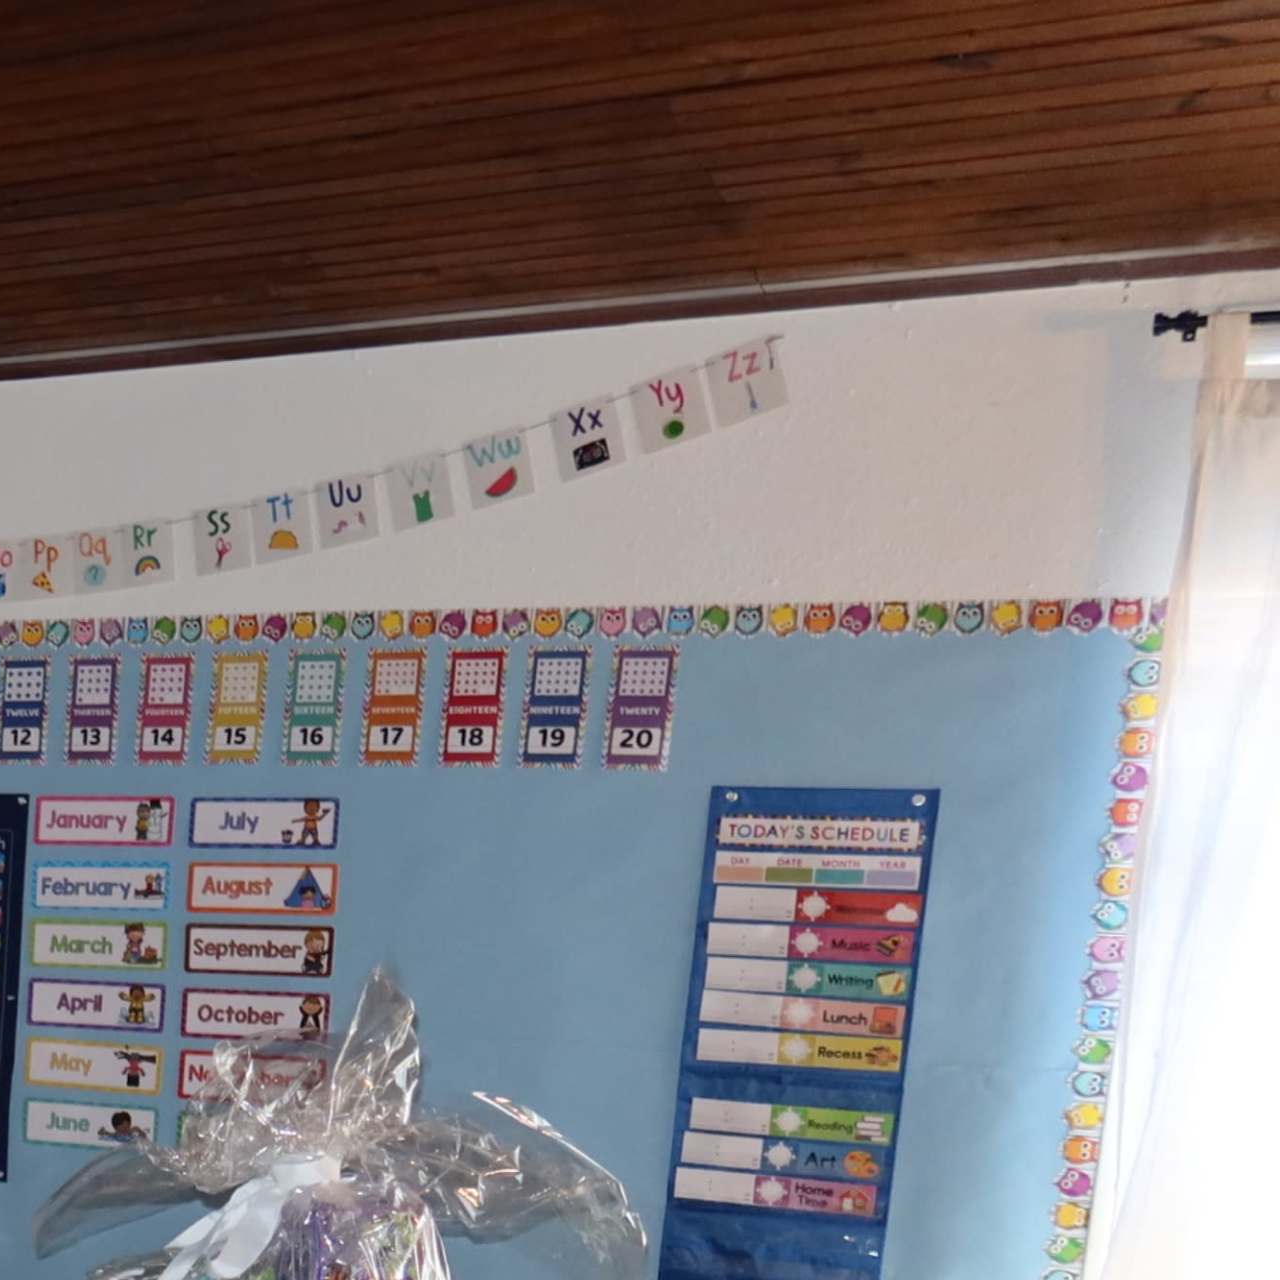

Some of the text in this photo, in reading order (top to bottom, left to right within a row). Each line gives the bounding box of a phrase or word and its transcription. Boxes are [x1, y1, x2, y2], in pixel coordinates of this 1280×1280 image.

[723, 351, 763, 383] Zz
[648, 379, 685, 414] Yy
[568, 407, 604, 436] Xx
[467, 435, 522, 467] Ww
[328, 480, 362, 507] Uu
[266, 492, 294, 522] Tt
[207, 510, 231, 537] Ss
[133, 524, 157, 551] Rr
[34, 539, 59, 574] Pp
[79, 532, 111, 566] Qq
[5, 708, 39, 718] TWELVE
[294, 705, 334, 715] SIXTEEN
[449, 705, 498, 715] EIGHTEEN
[529, 705, 580, 715] NINETEEN
[620, 706, 660, 716] TWENTY
[11, 728, 31, 745] 12
[79, 728, 100, 746] 13
[151, 728, 174, 745] 14
[224, 727, 246, 745] 15
[299, 727, 324, 745] 16
[380, 727, 403, 745] 17
[457, 727, 483, 746] 18
[538, 728, 565, 747] 19
[619, 729, 653, 748] 20
[46, 809, 127, 833] January
[219, 811, 259, 833] July
[728, 822, 910, 843] TODAY'S SCHEDULE
[730, 856, 906, 870] DAY DATE MONTH YEAR
[41, 877, 131, 900] February
[202, 876, 274, 899] August
[49, 935, 113, 956] March
[193, 938, 303, 961] September
[831, 938, 871, 952] Music
[828, 974, 874, 990] Writing
[57, 992, 103, 1016] April
[197, 1004, 284, 1025] October
[822, 1010, 868, 1026] Lunch
[817, 1046, 862, 1060] Recess
[49, 1052, 93, 1076] May
[46, 1112, 90, 1132] June
[807, 1118, 854, 1135] Reading
[804, 1152, 836, 1167] Art
[795, 1183, 834, 1198] Home
[797, 1195, 828, 1208] Time
